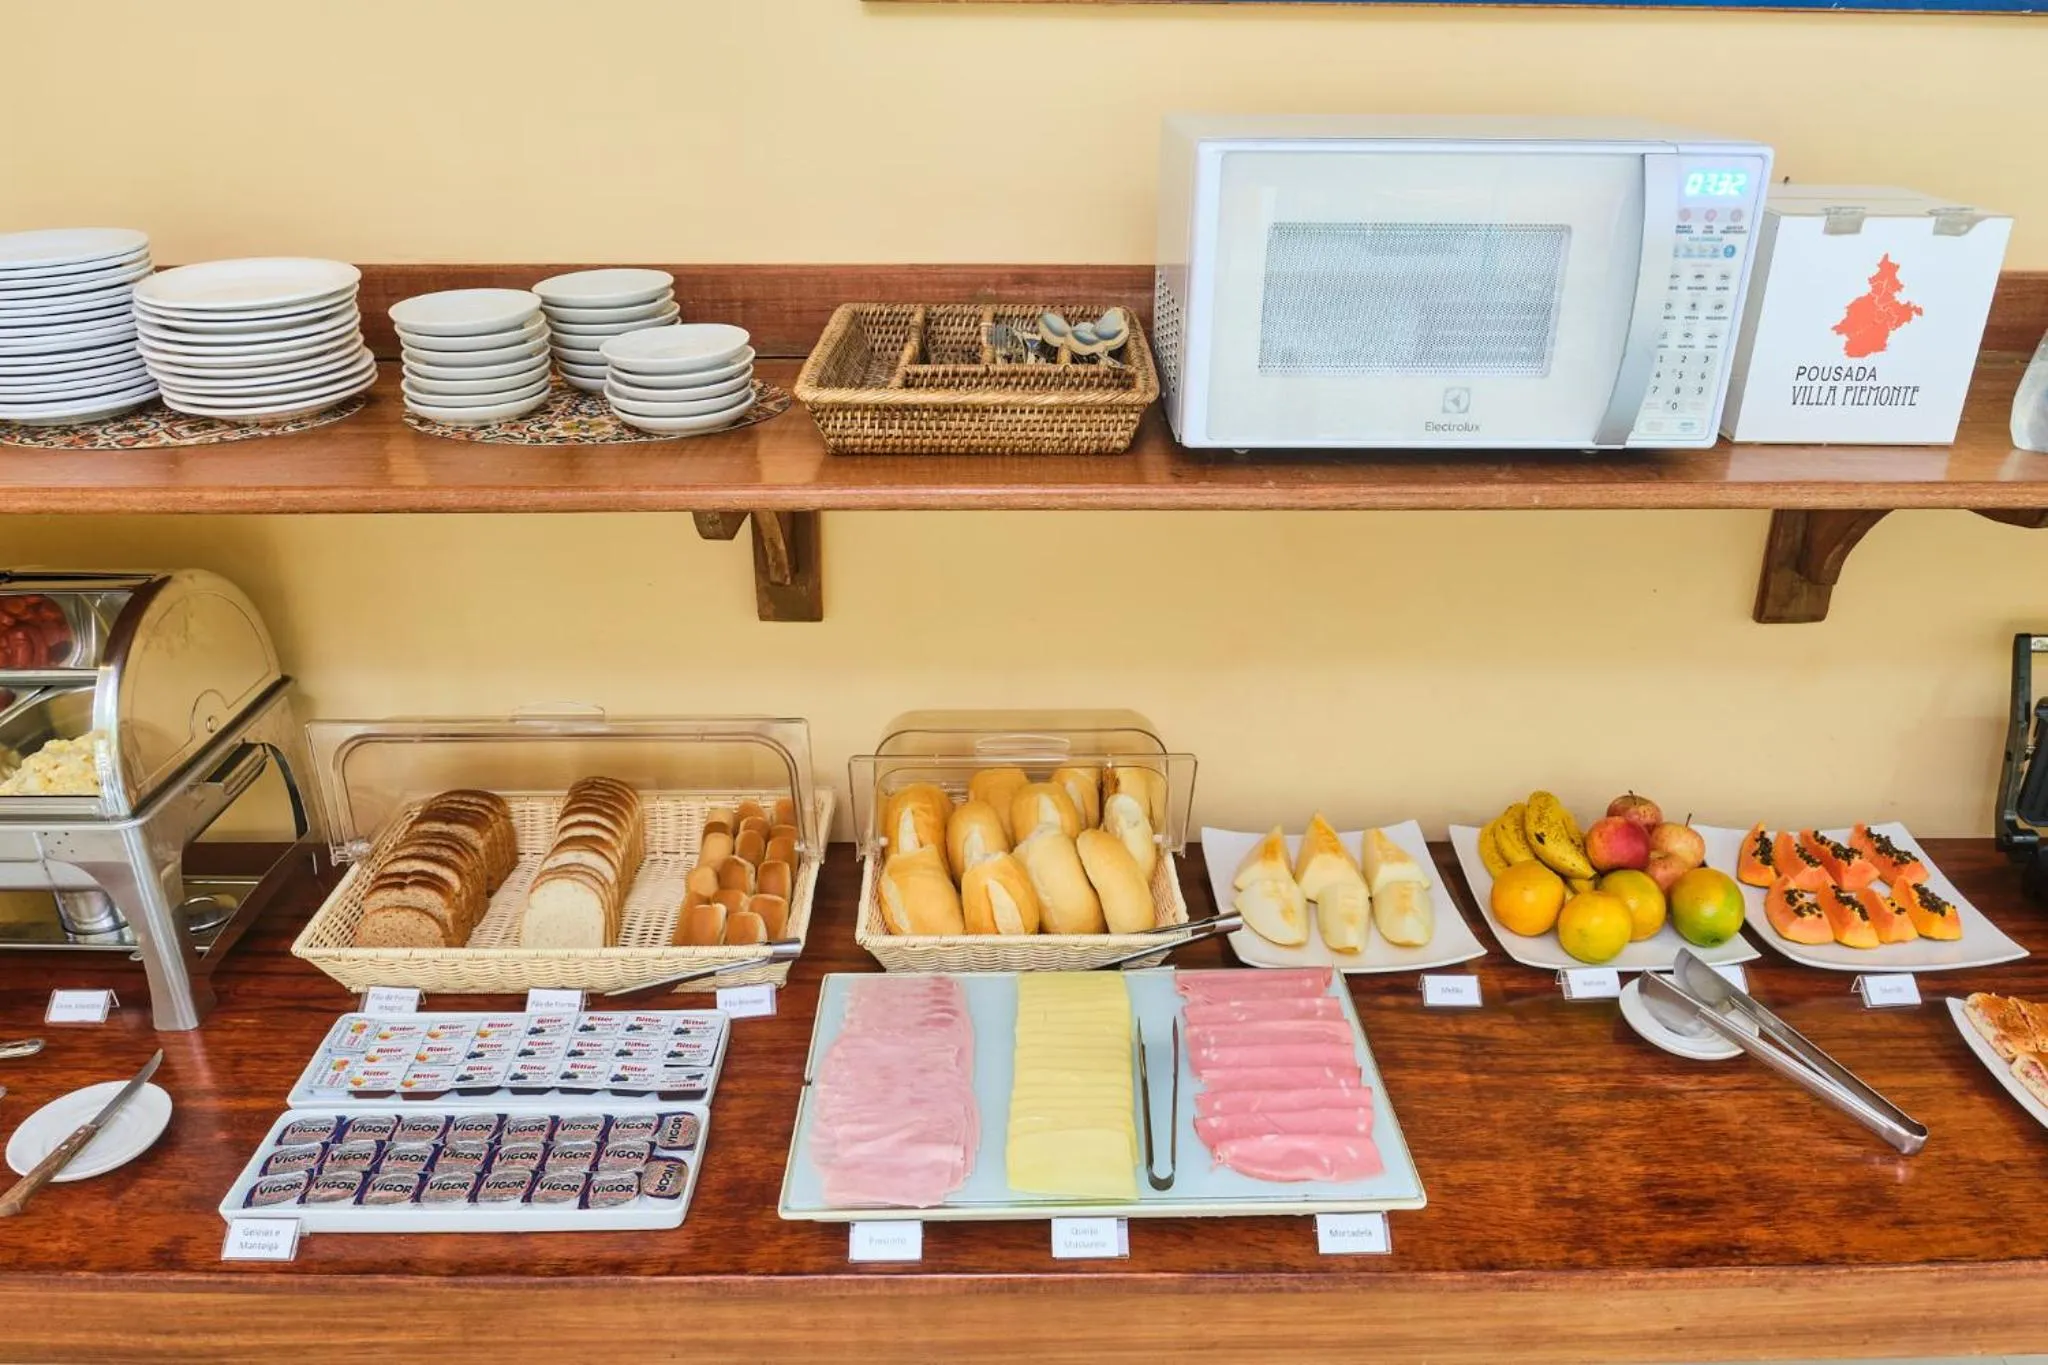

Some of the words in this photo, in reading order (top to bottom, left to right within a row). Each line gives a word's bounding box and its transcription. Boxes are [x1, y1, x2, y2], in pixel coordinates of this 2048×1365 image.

[1795, 366, 1877, 381] POUSADA
[1792, 385, 1837, 406] VILLA
[1842, 385, 1920, 406] PIEMONTE
[1424, 421, 1480, 432] Electrolux
[290, 1125, 331, 1134] VIGOR
[351, 1124, 392, 1133] VIGOR
[400, 1123, 440, 1132] VIGOR
[453, 1123, 493, 1132] VIGOR
[507, 1124, 546, 1135] VIGOR
[560, 1123, 600, 1131] VIGOR
[614, 1121, 654, 1130] VIGOR
[667, 1116, 685, 1144] VIGOR
[274, 1152, 317, 1164] VIGOR
[330, 1152, 371, 1162] VIGOR
[387, 1153, 428, 1162] VIGOR
[443, 1150, 483, 1160] VIGOR
[499, 1151, 538, 1161] VIGOR
[552, 1151, 592, 1159] VIGOR
[605, 1149, 645, 1160] VIGOR
[655, 1164, 678, 1193] VIGOR
[259, 1181, 303, 1195] VIGOR
[314, 1181, 357, 1191] VIGOR
[371, 1183, 413, 1194] VIGOR
[429, 1181, 470, 1191] VIGOR
[485, 1180, 526, 1190] VIGOR
[539, 1181, 580, 1192] VIGOR
[593, 1184, 635, 1194] VIGOR
